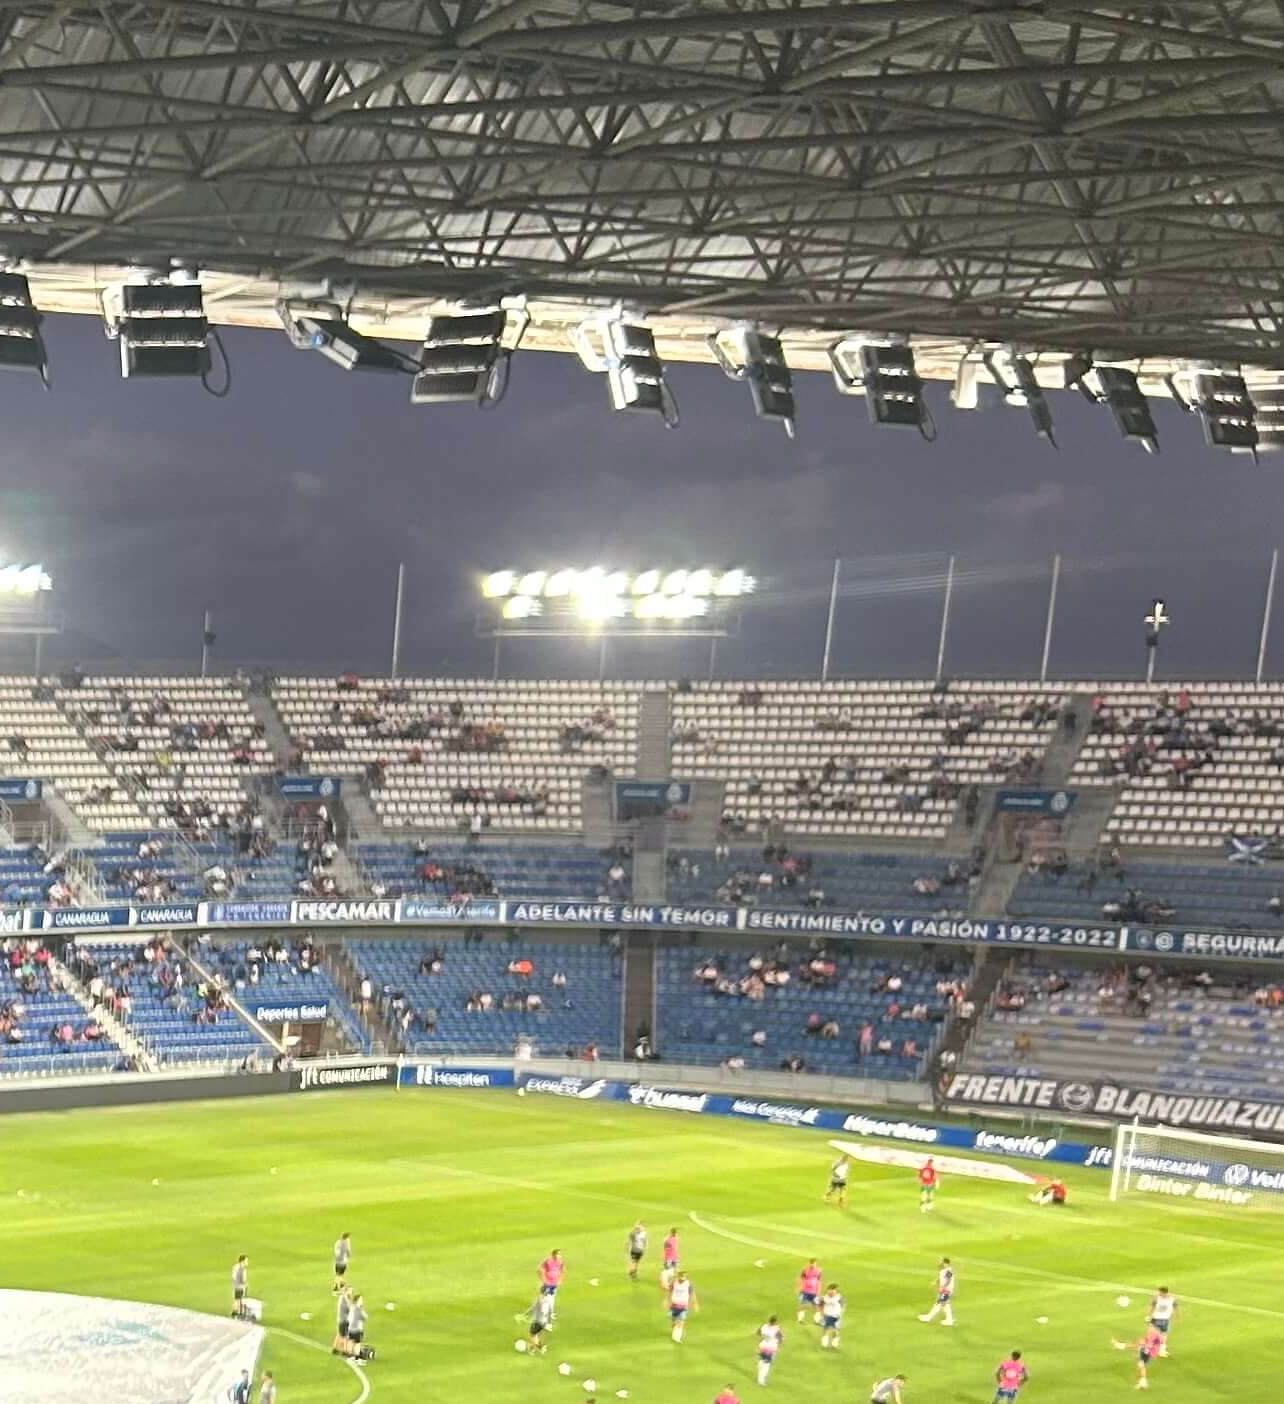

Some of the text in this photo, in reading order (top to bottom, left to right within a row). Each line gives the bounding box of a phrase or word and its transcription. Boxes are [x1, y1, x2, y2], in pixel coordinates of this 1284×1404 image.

[298, 902, 391, 921] PESCAMAR
[513, 904, 730, 926] ADELANTE SIN TEMOR
[748, 912, 1116, 946] SENTIMIENTO Y PASIÓN 1922-2022
[319, 1064, 388, 1085] COMUNICACIÓN
[947, 1073, 1058, 1107] FRENTE
